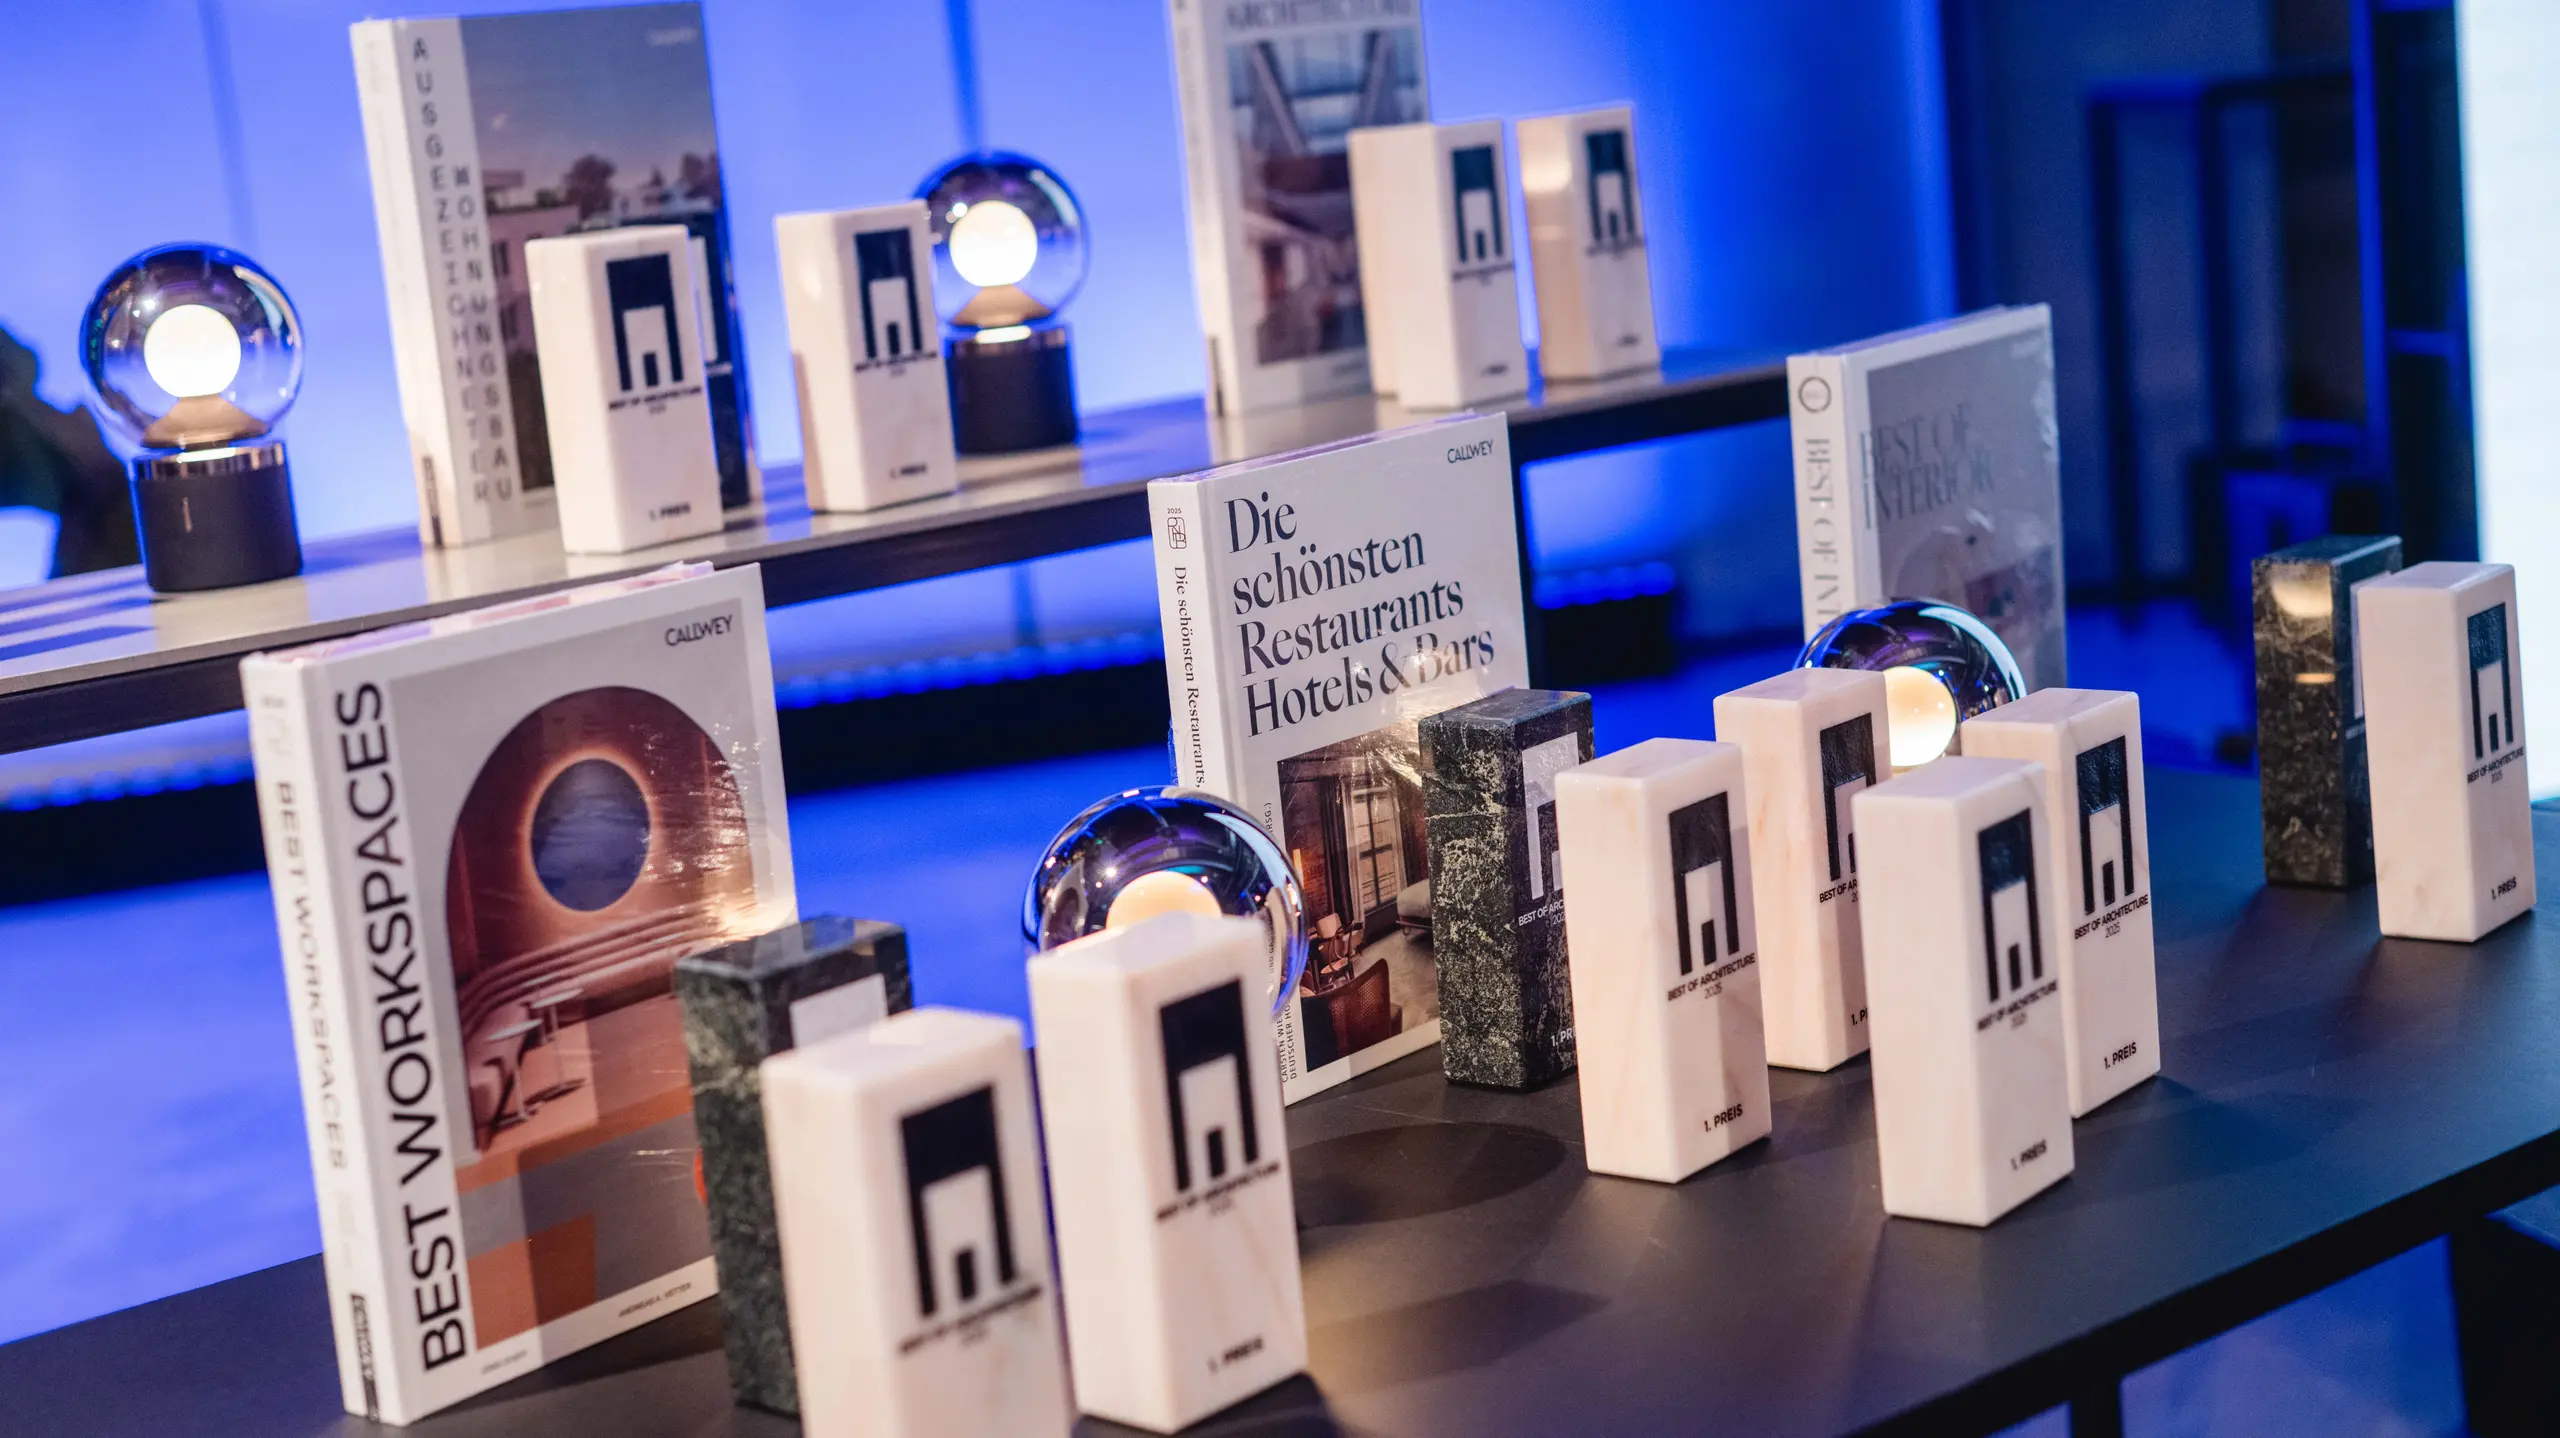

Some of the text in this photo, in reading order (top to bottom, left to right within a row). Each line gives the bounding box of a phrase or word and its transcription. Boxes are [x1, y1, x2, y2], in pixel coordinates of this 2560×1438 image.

[1446, 438, 1494, 465] CALLWEY
[1805, 438, 1834, 506] BEST
[1223, 491, 1298, 554] Die
[1232, 531, 1426, 616] schönsten
[664, 613, 735, 649] CALLWEY
[1236, 580, 1465, 677] Restaurants
[1174, 565, 1206, 789] Die schönsten Restaurants,
[1242, 629, 1496, 739] Hotels & Bars
[1518, 909, 1537, 927] BEST
[1537, 904, 1548, 918] OF
[1819, 887, 1836, 903] BEST
[2074, 893, 2149, 940] BEST OF ARCHITECTURE
[1668, 952, 1756, 1002] BEST OF ARCHITECTURE
[334, 681, 468, 1373] WORKSPACES BEST
[1286, 1021, 1297, 1080] DEUTSCHER
[1278, 1038, 1288, 1083] CARSTEN
[2112, 1041, 2137, 1066] PREIS
[1713, 1103, 1744, 1129] PREIS
